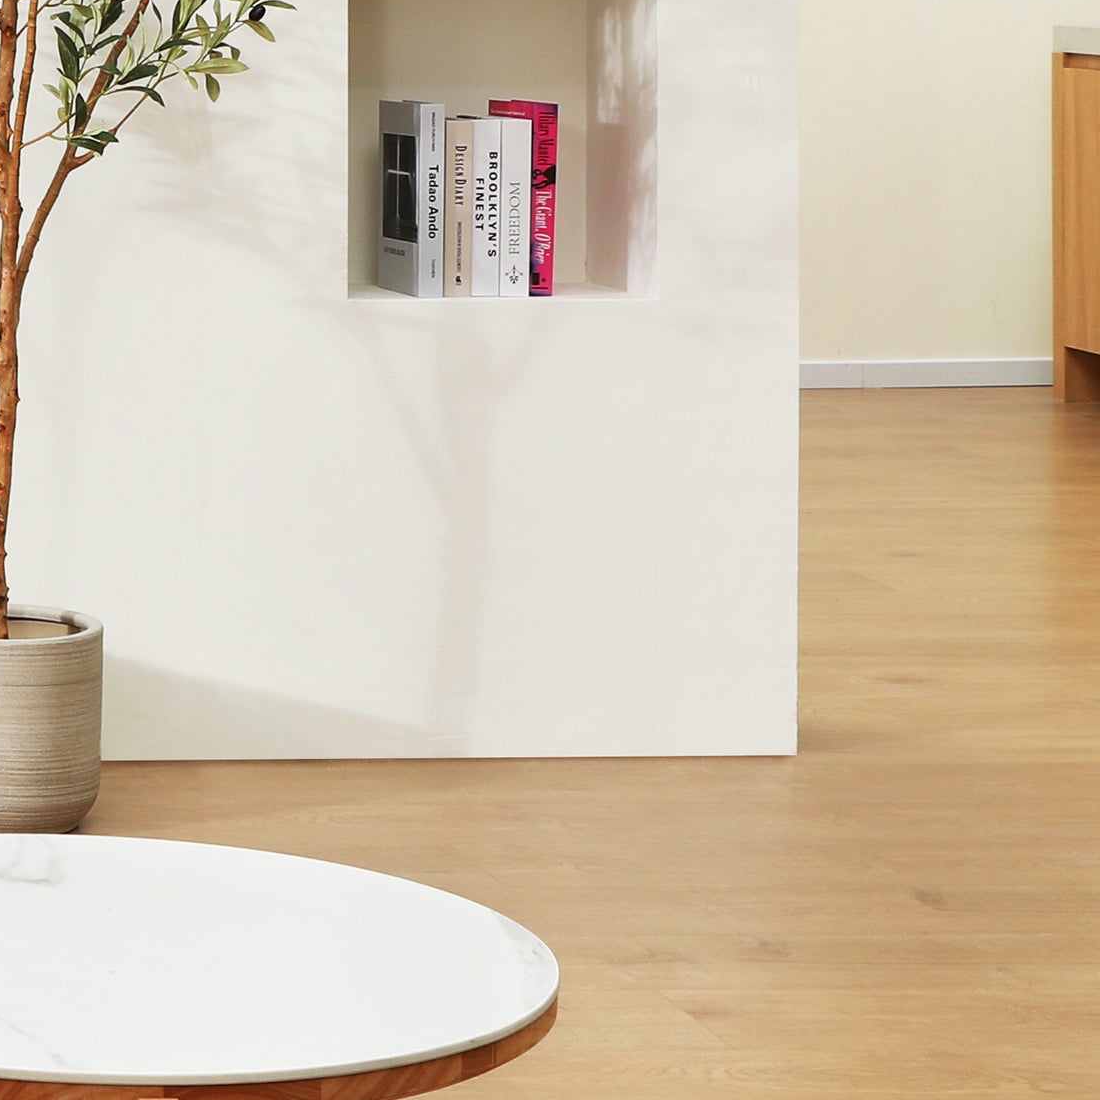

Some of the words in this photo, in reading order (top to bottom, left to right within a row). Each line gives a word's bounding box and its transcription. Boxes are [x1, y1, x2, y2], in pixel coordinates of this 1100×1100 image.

[454, 145, 468, 178] DESIGN
[428, 164, 440, 204] Tadao
[454, 178, 468, 207] DIARY
[534, 190, 553, 206] The
[474, 177, 485, 231] FINEST
[487, 151, 499, 258] BROOLKLYN'S
[508, 182, 521, 256] FREEDOM
[428, 206, 440, 240] Ando
